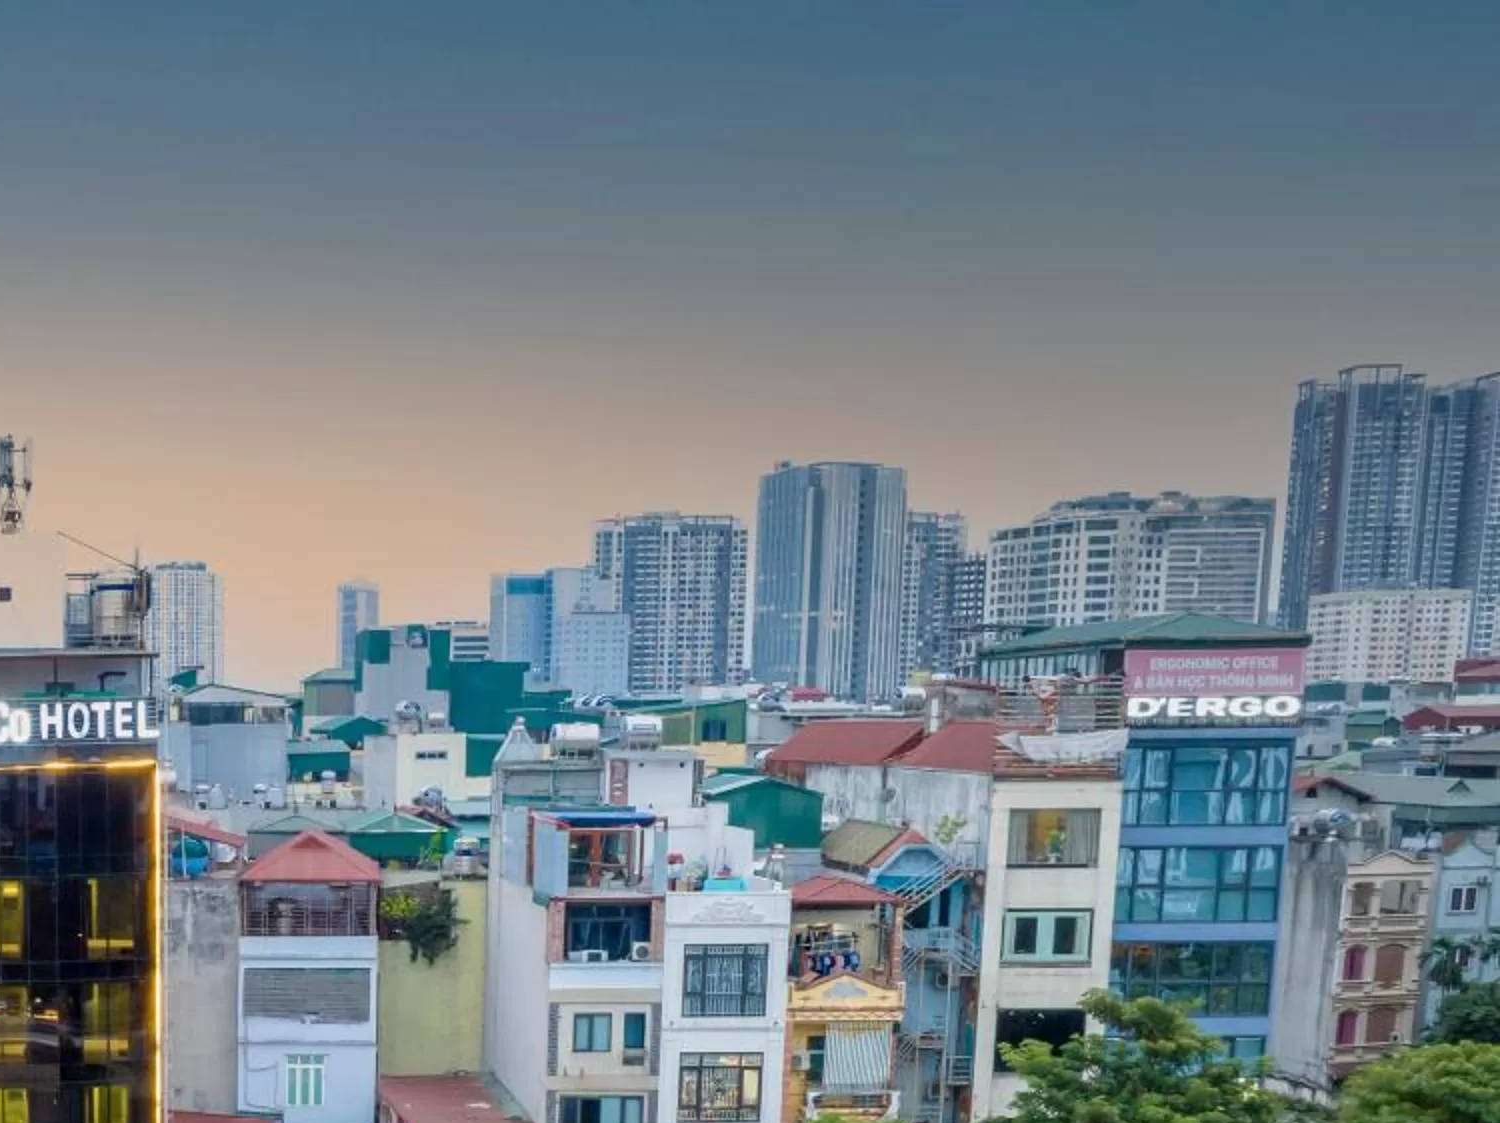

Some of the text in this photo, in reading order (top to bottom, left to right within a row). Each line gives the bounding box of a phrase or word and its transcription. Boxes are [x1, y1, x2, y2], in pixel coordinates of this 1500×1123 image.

[1150, 655, 1279, 670] ERGONOMIC OFFICE
[1127, 696, 1302, 718] D'ERGO
[40, 701, 161, 739] HOTEL
